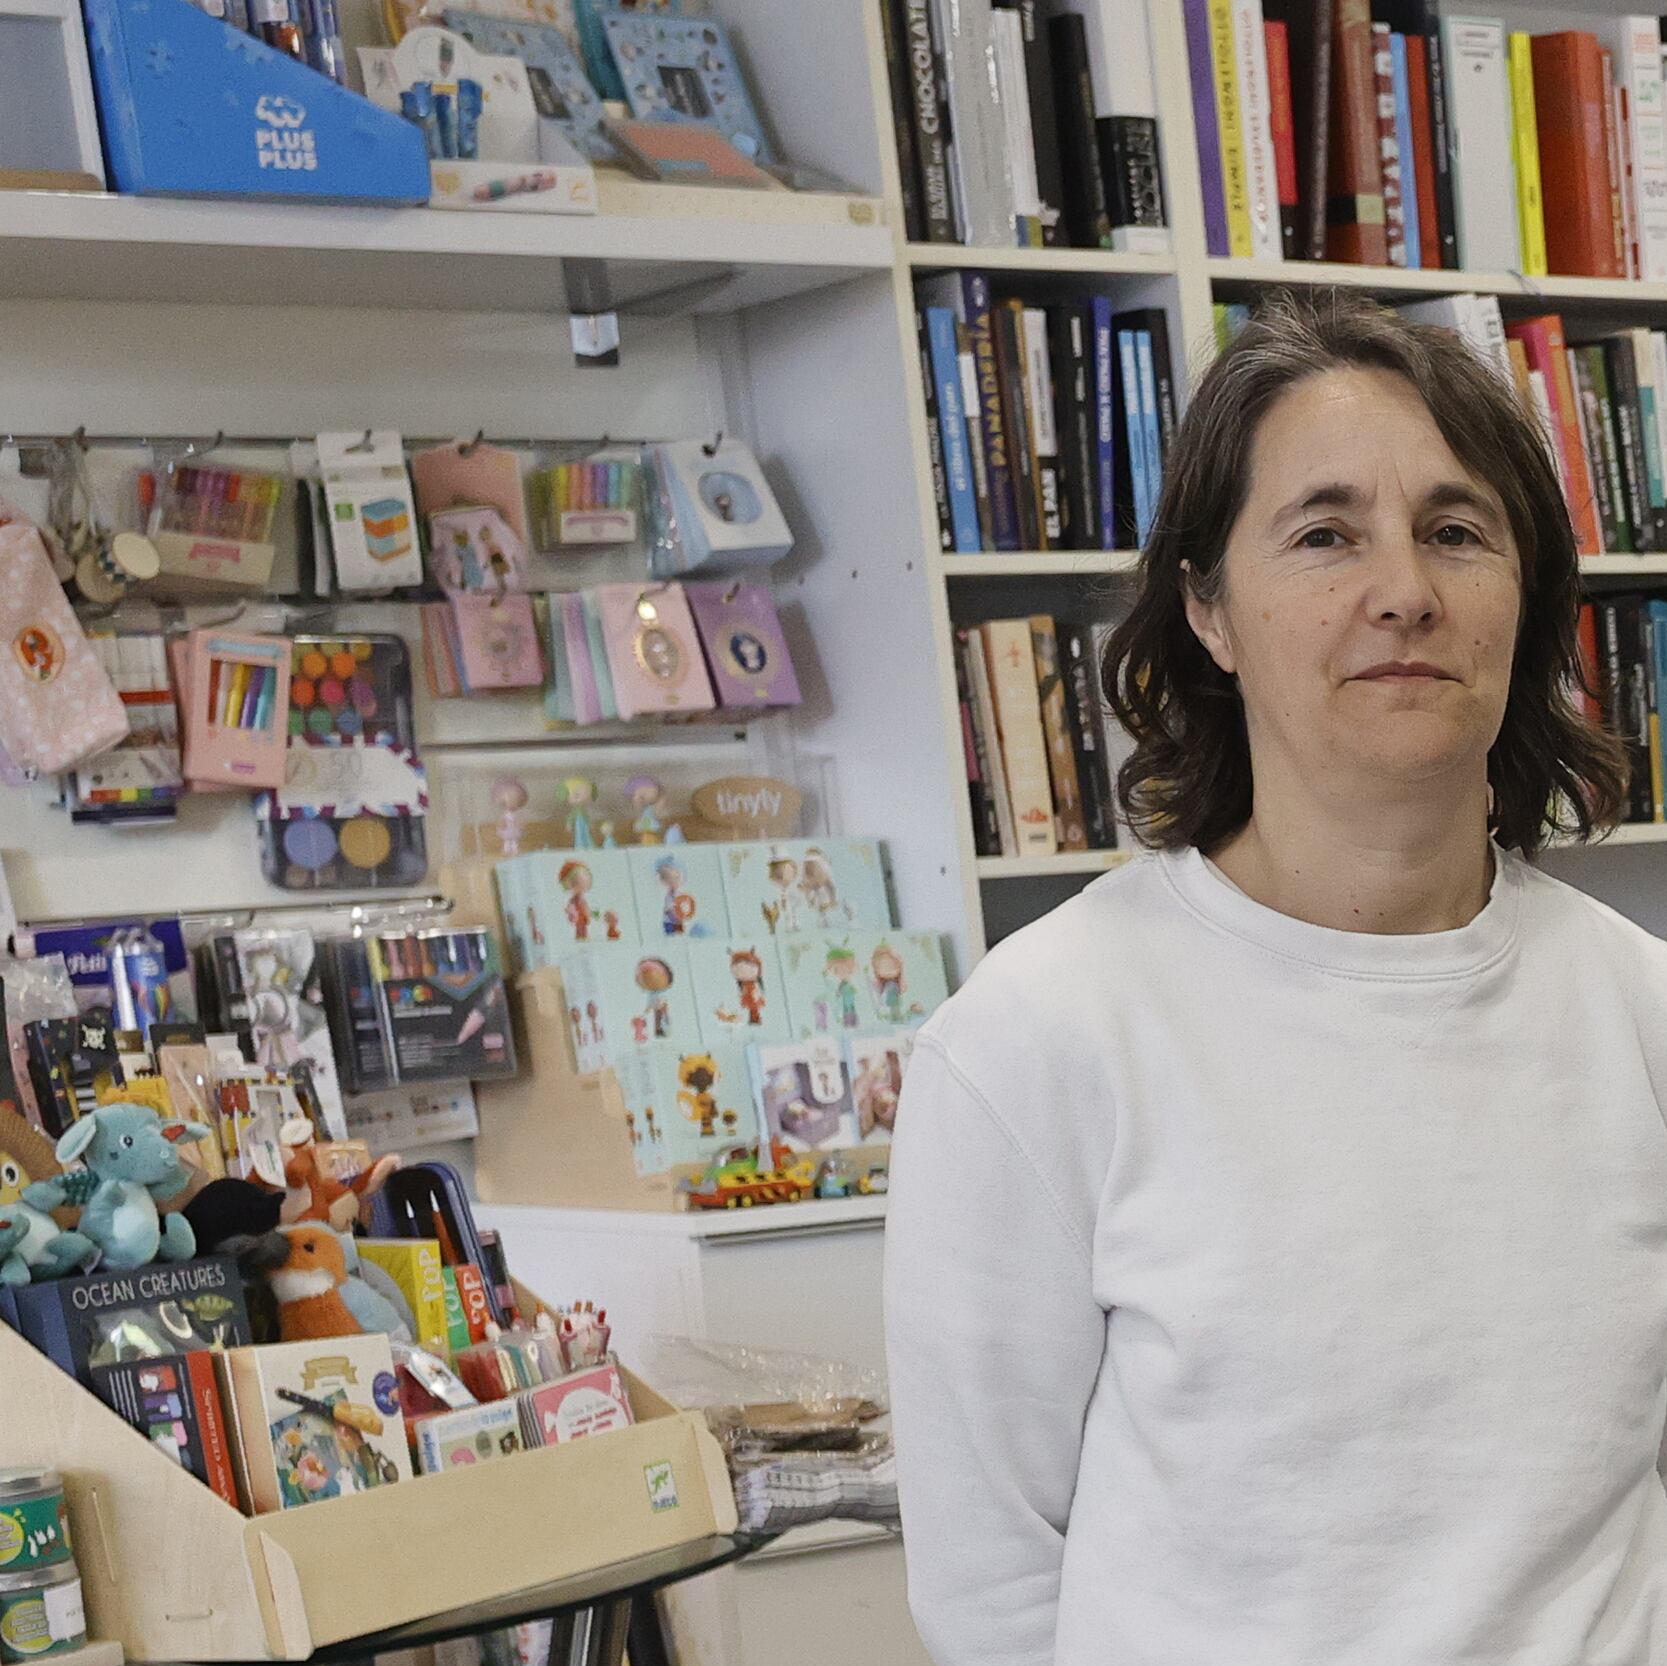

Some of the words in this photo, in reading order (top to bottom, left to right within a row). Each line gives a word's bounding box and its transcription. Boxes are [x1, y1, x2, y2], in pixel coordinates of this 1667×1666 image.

[255, 128, 314, 149] PLUS
[258, 149, 318, 172] PLUS
[72, 1279, 134, 1310] OCEAN
[140, 1266, 225, 1298] CREATURES
[420, 1249, 443, 1302] POP
